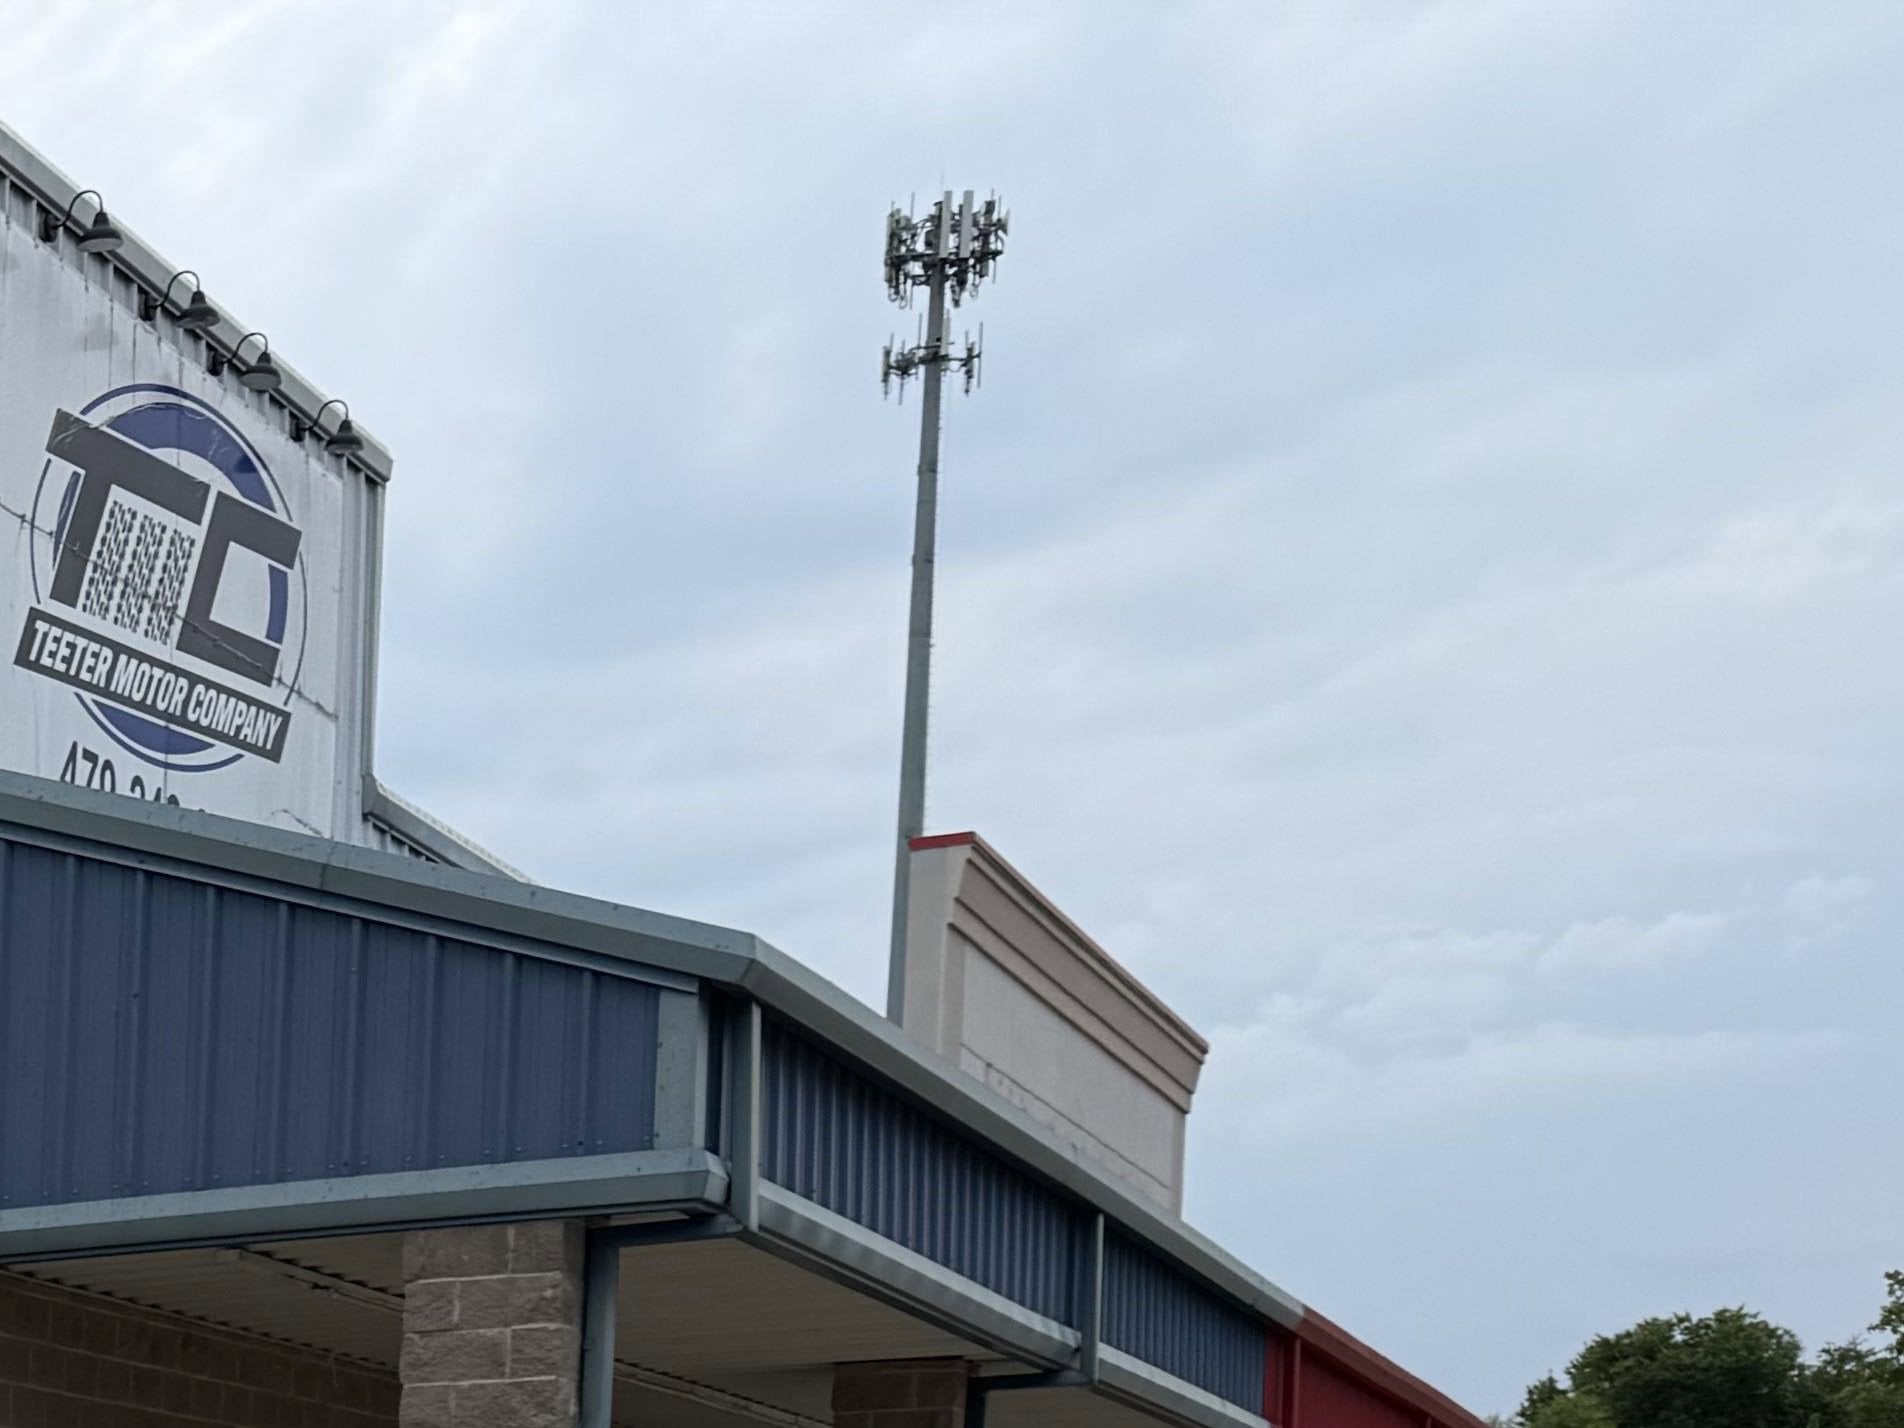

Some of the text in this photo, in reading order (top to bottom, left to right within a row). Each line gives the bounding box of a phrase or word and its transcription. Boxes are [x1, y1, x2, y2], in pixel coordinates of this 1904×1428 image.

[28, 619, 284, 751] TEETER MOTOR COMPANY
